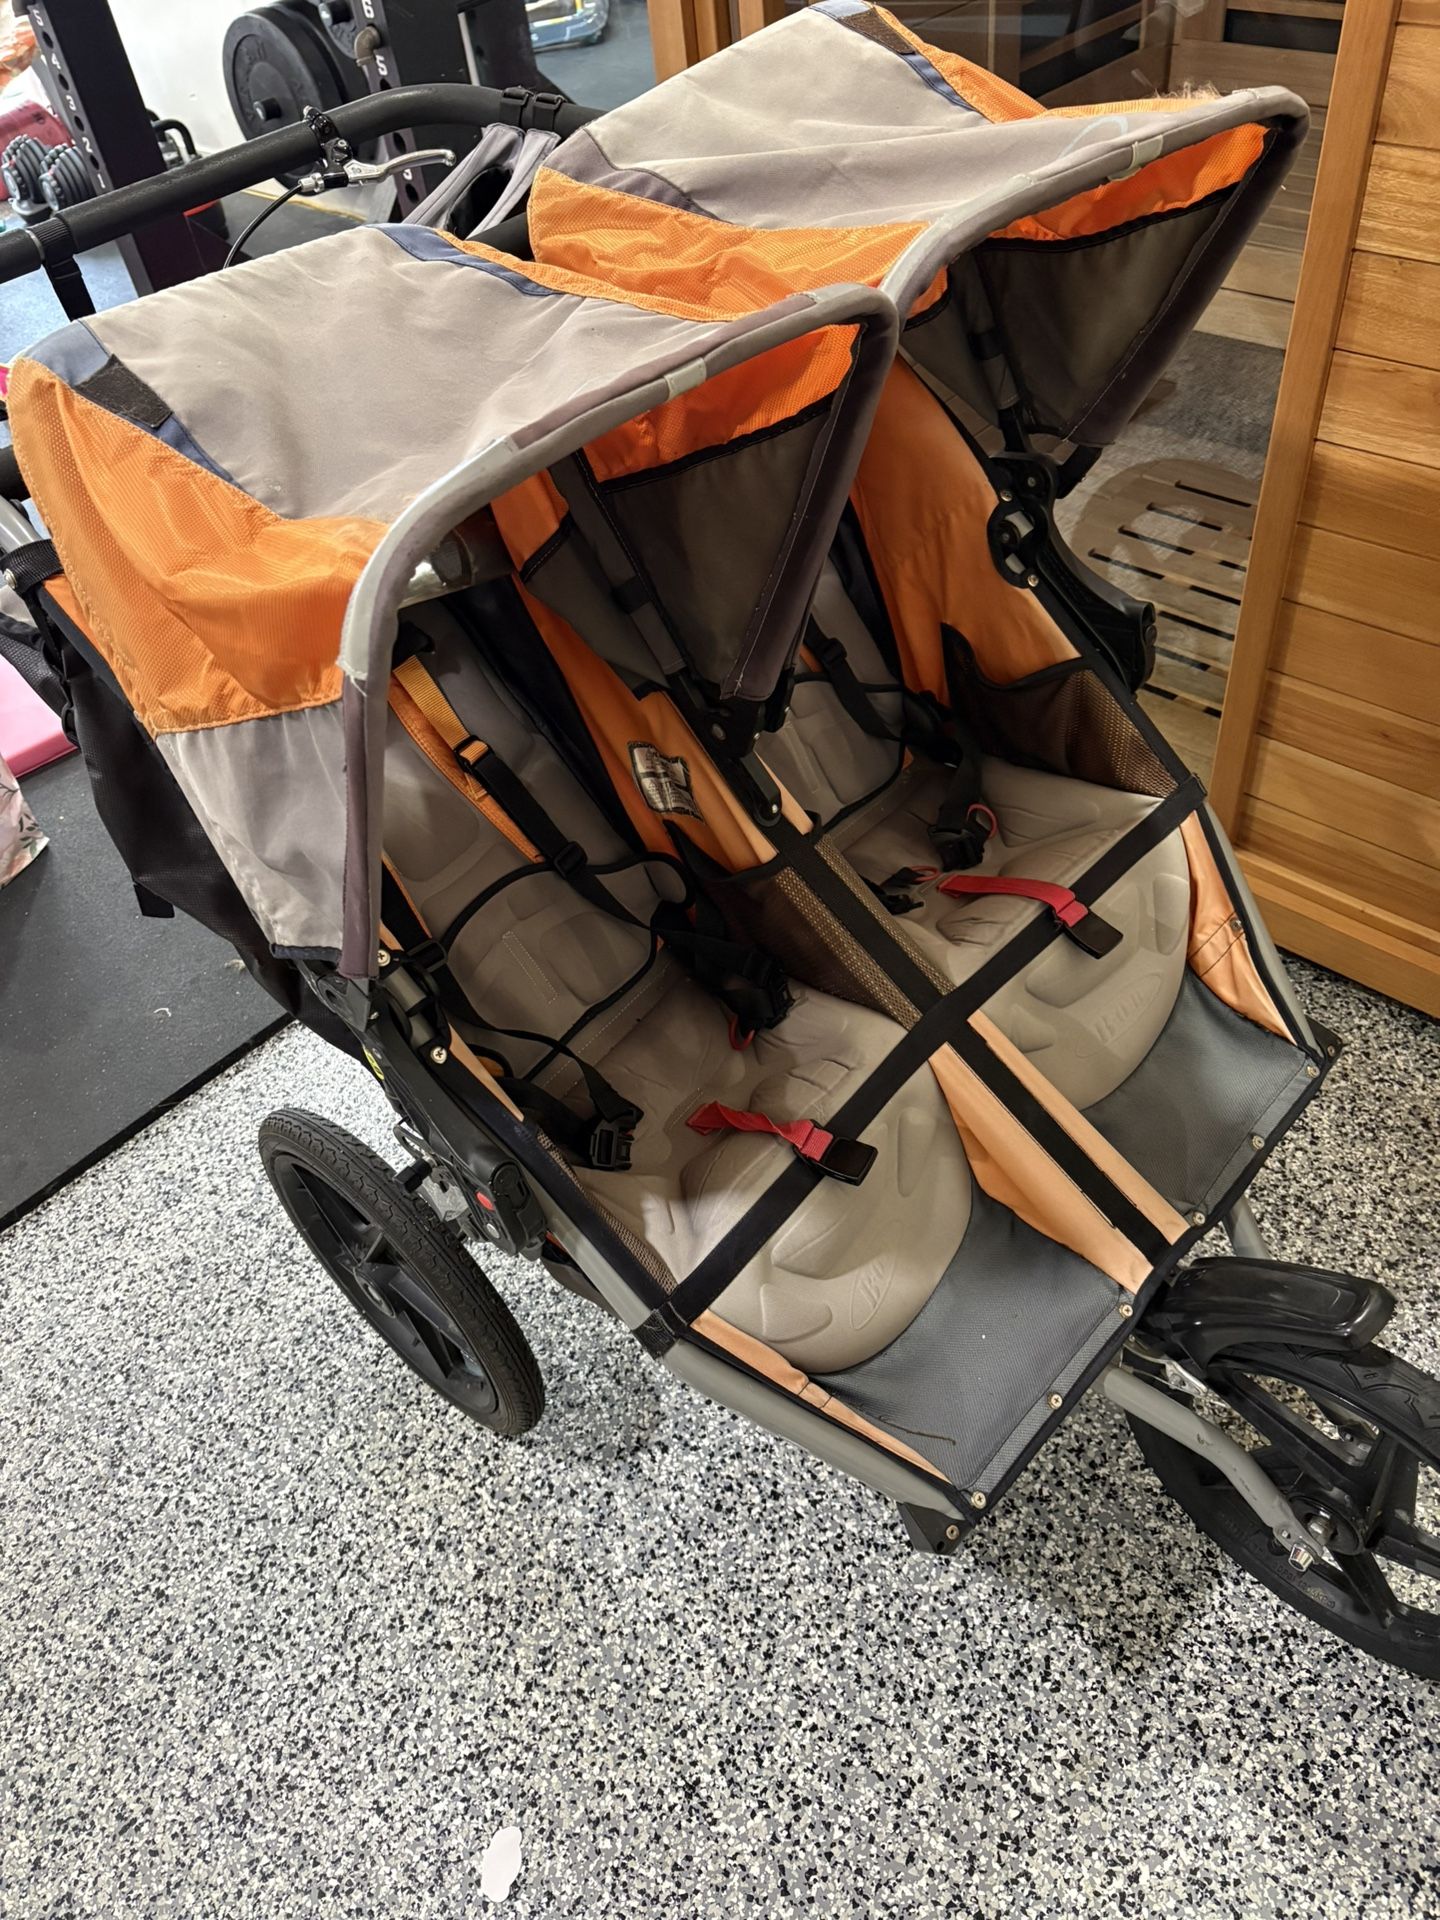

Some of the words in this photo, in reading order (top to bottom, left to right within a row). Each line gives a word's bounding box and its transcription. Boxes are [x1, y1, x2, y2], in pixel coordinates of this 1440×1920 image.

[33, 9, 44, 27] 5
[361, 0, 375, 19] 6
[51, 53, 61, 70] 4
[375, 54, 388, 76] 5
[66, 94, 77, 111] 3
[82, 136, 93, 153] 2
[97, 173, 106, 188] 1
